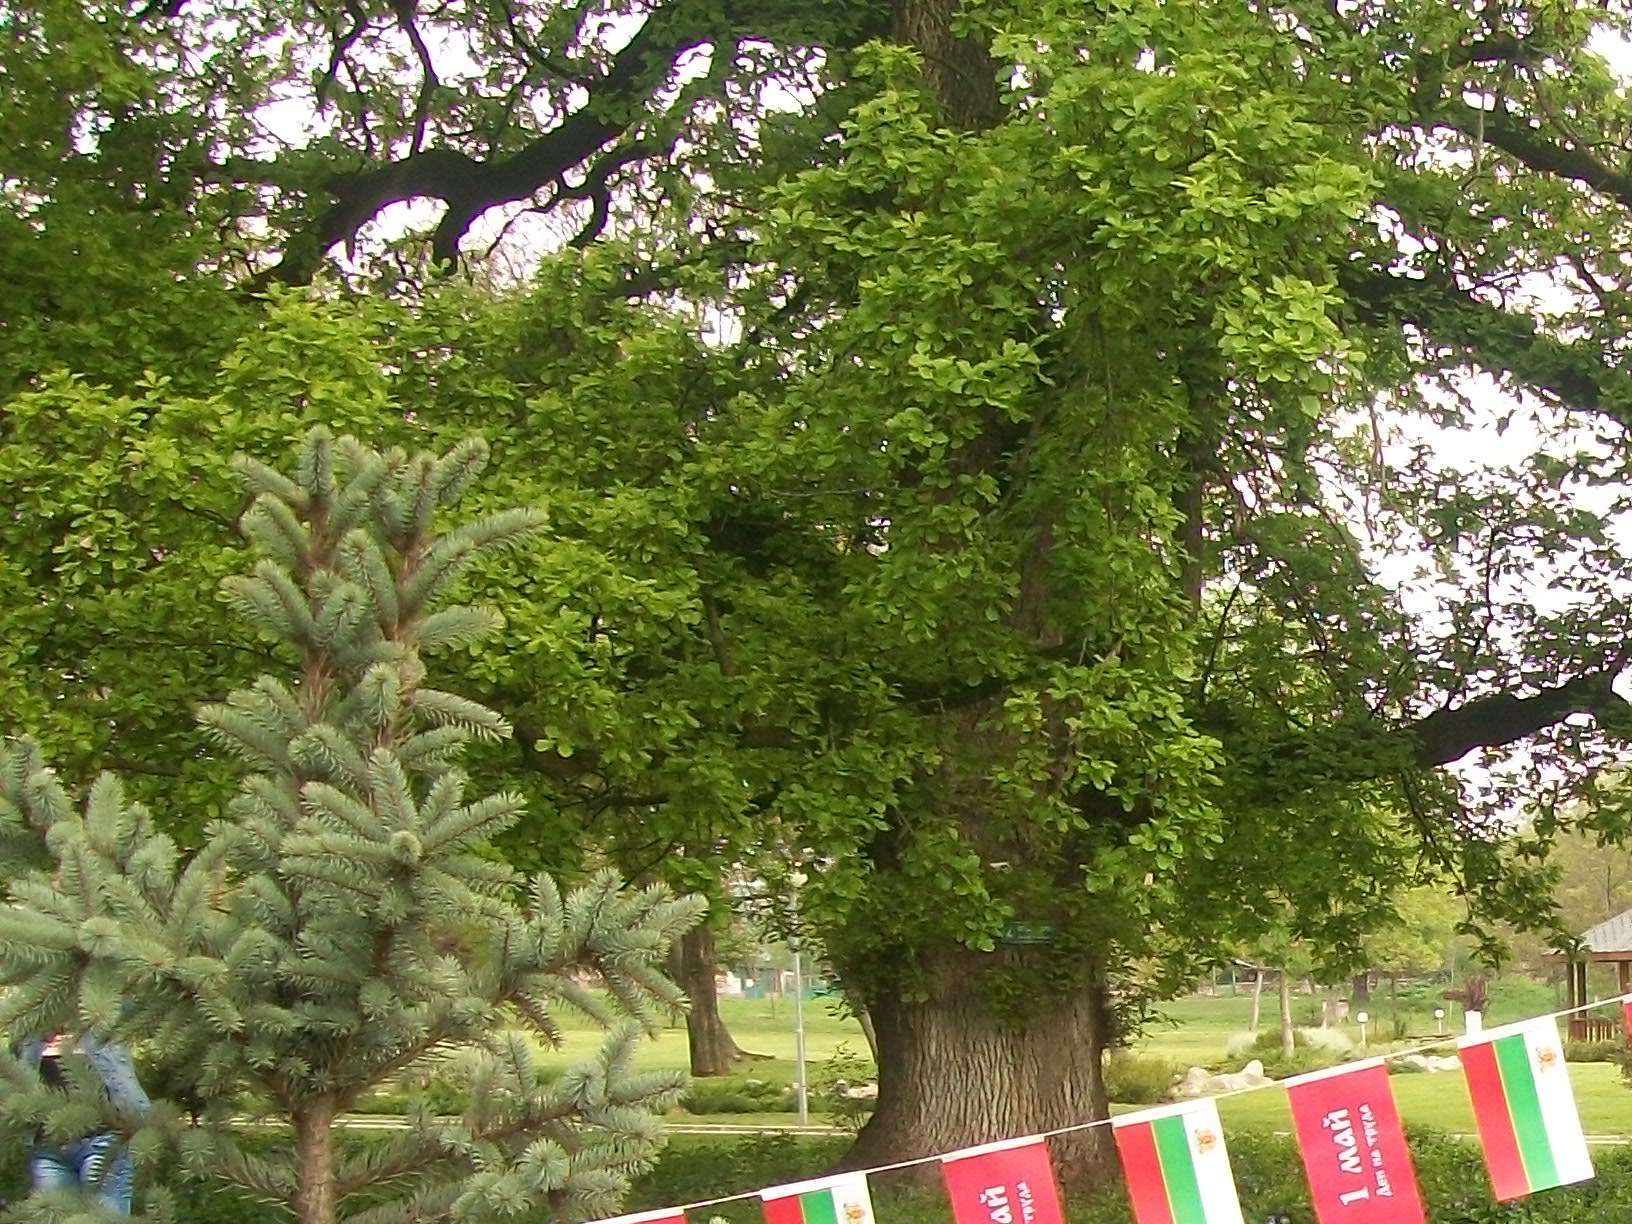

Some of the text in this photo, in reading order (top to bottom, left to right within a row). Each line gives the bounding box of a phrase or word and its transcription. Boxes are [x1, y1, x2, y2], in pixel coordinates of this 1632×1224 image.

[1322, 1109, 1370, 1206] 1 май
[1359, 1104, 1393, 1197] Ден на труда
[1016, 1181, 1036, 1224] труда
